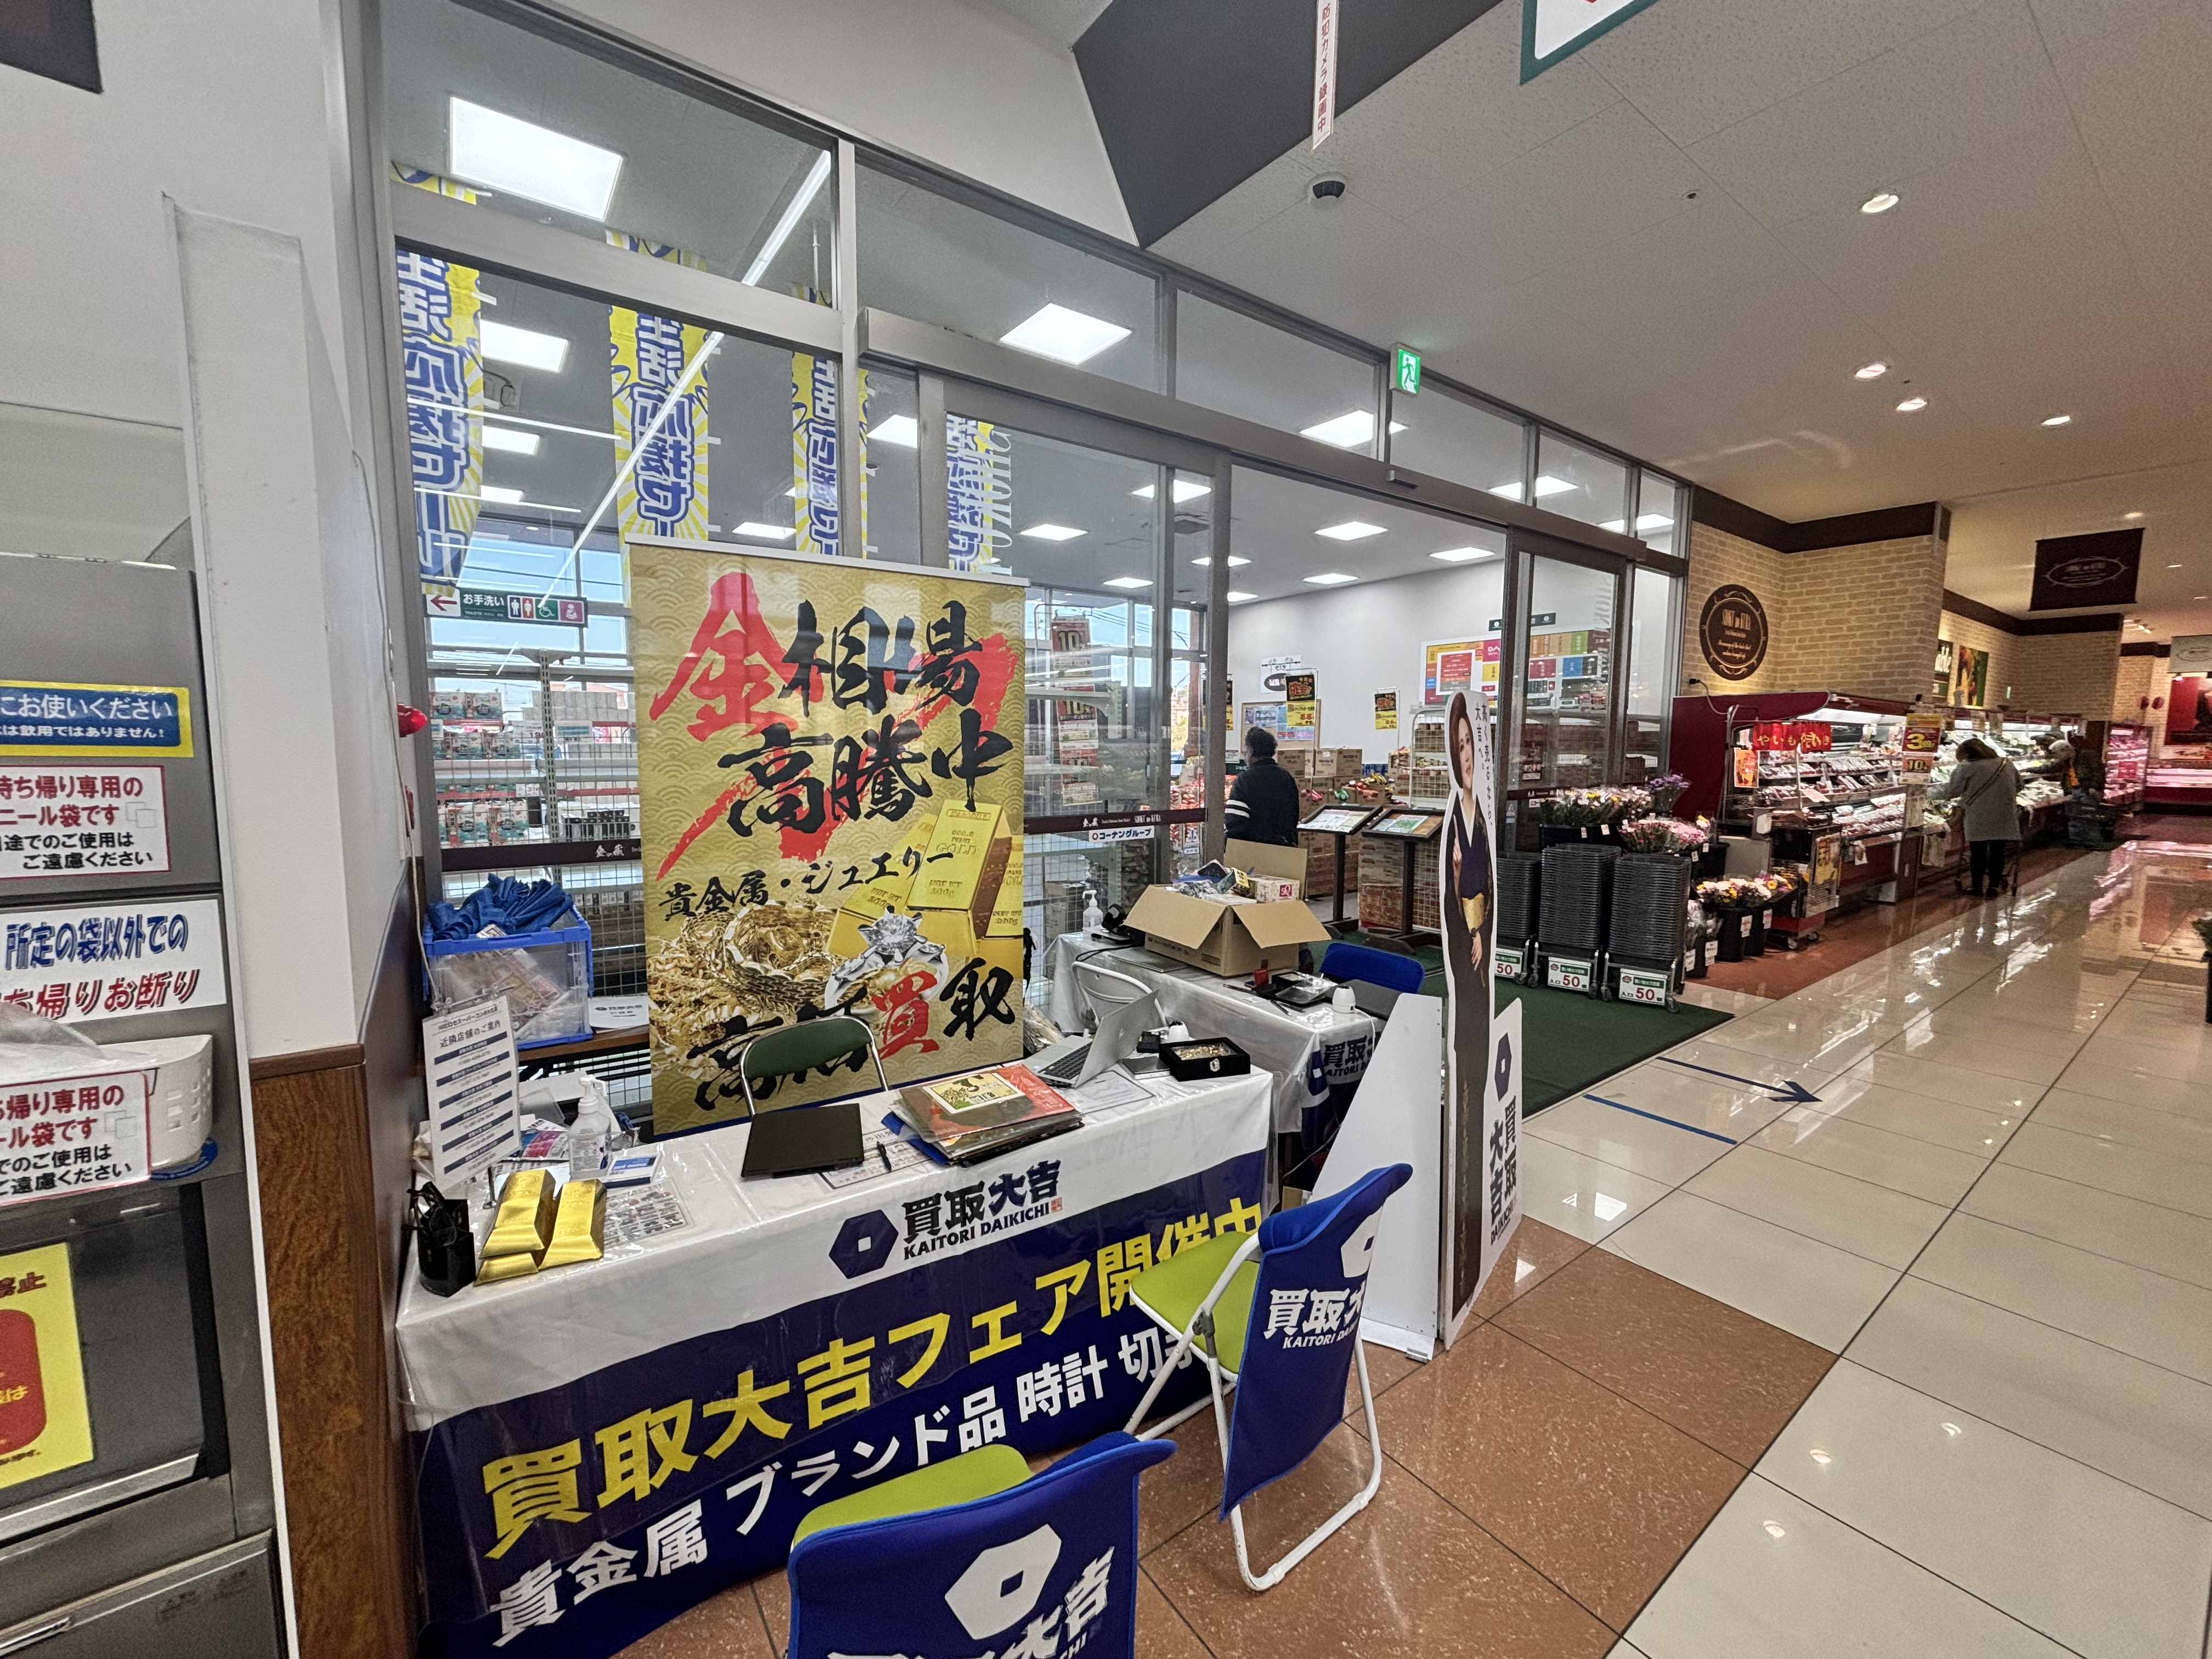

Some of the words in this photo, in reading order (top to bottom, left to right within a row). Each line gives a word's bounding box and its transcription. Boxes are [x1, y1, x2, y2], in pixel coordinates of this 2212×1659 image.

[463, 594, 505, 607] お手洗い
[650, 571, 983, 742] 金相場
[0, 725, 164, 738] は飲用ではありません!
[0, 832, 134, 851] 途でのご使用は
[1099, 827, 1152, 840] コーナングループ
[22, 851, 153, 870] ご遠慮ください
[5, 914, 189, 970] 所定の袋以外での
[1497, 963, 1513, 975] 50
[1563, 974, 1581, 988] 50
[1, 969, 200, 1019] ち帰りお断り
[1635, 988, 1655, 1001] 50
[1326, 1063, 1359, 1076] AITORI
[901, 1160, 1062, 1244] 買取大吉
[904, 1228, 977, 1261] KAITORI
[980, 1201, 1051, 1237] DAIKICHI
[1282, 1336, 1335, 1349] KAITORI
[489, 1499, 708, 1648] 貴金属
[726, 1386, 1007, 1536] ブランド品
[1016, 1345, 1108, 1424] 時計
